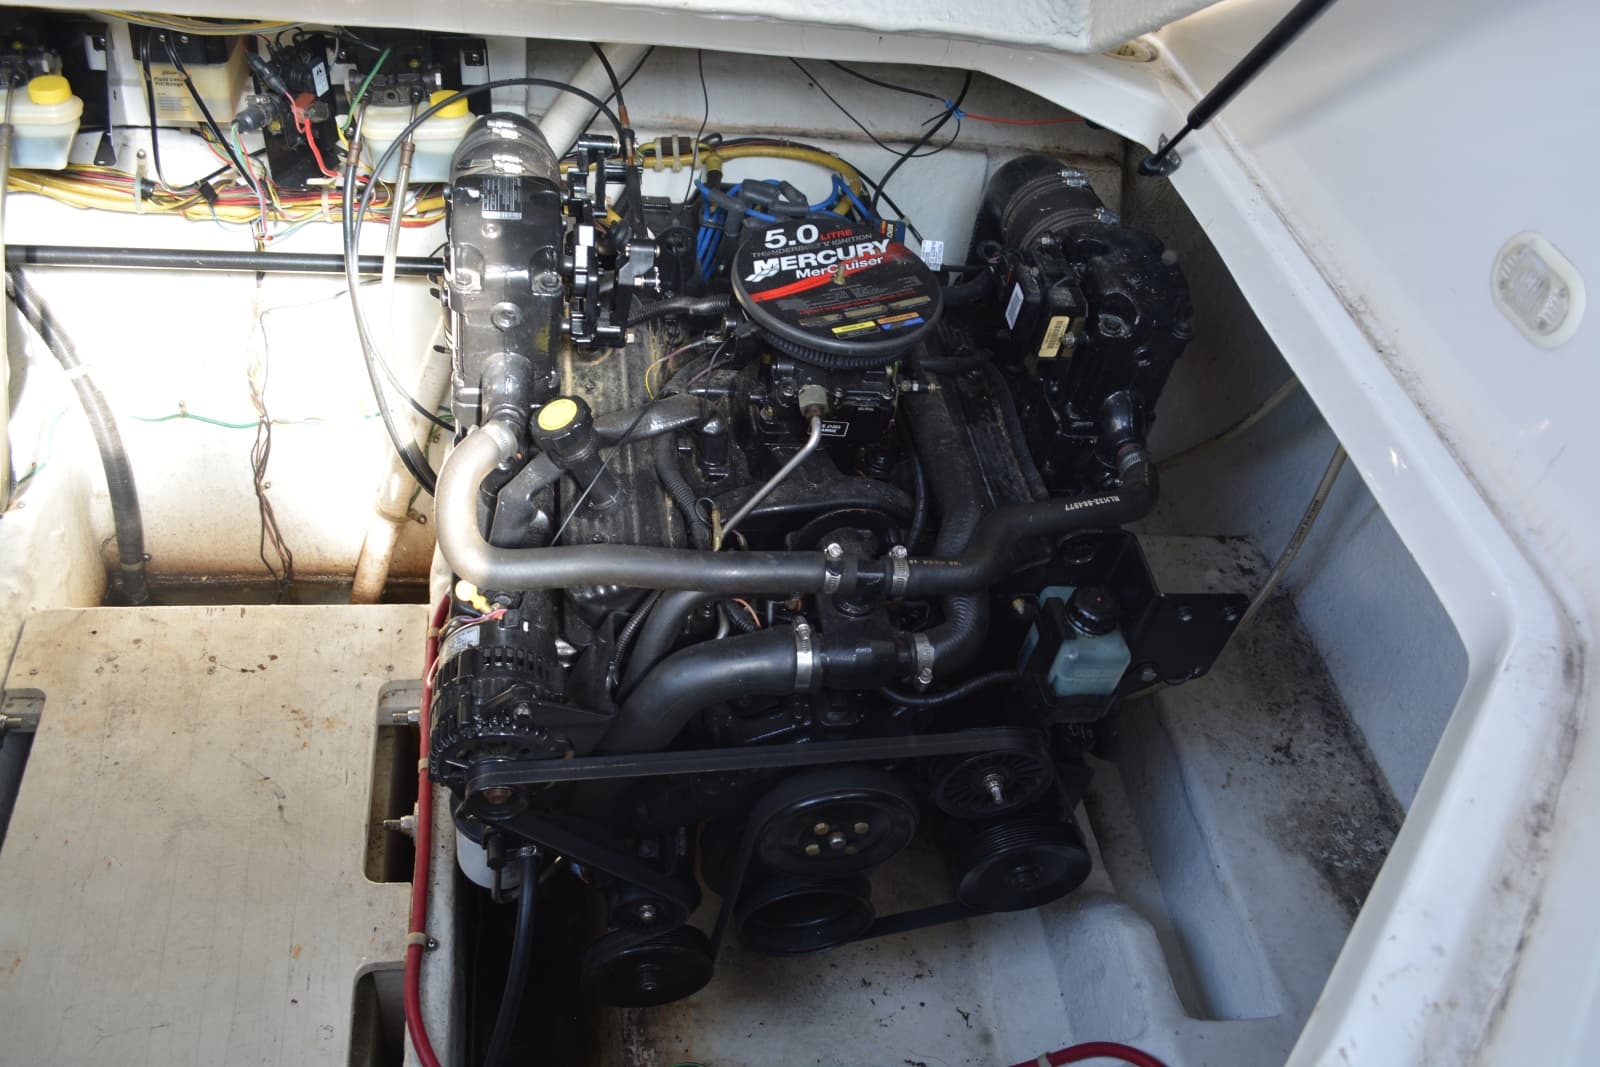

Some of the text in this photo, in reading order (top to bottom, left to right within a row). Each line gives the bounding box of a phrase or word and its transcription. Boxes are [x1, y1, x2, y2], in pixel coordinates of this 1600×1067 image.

[764, 223, 854, 249] 5.0 LITRE
[752, 238, 890, 275] MERCURY
[795, 256, 884, 279] MerCuiser
